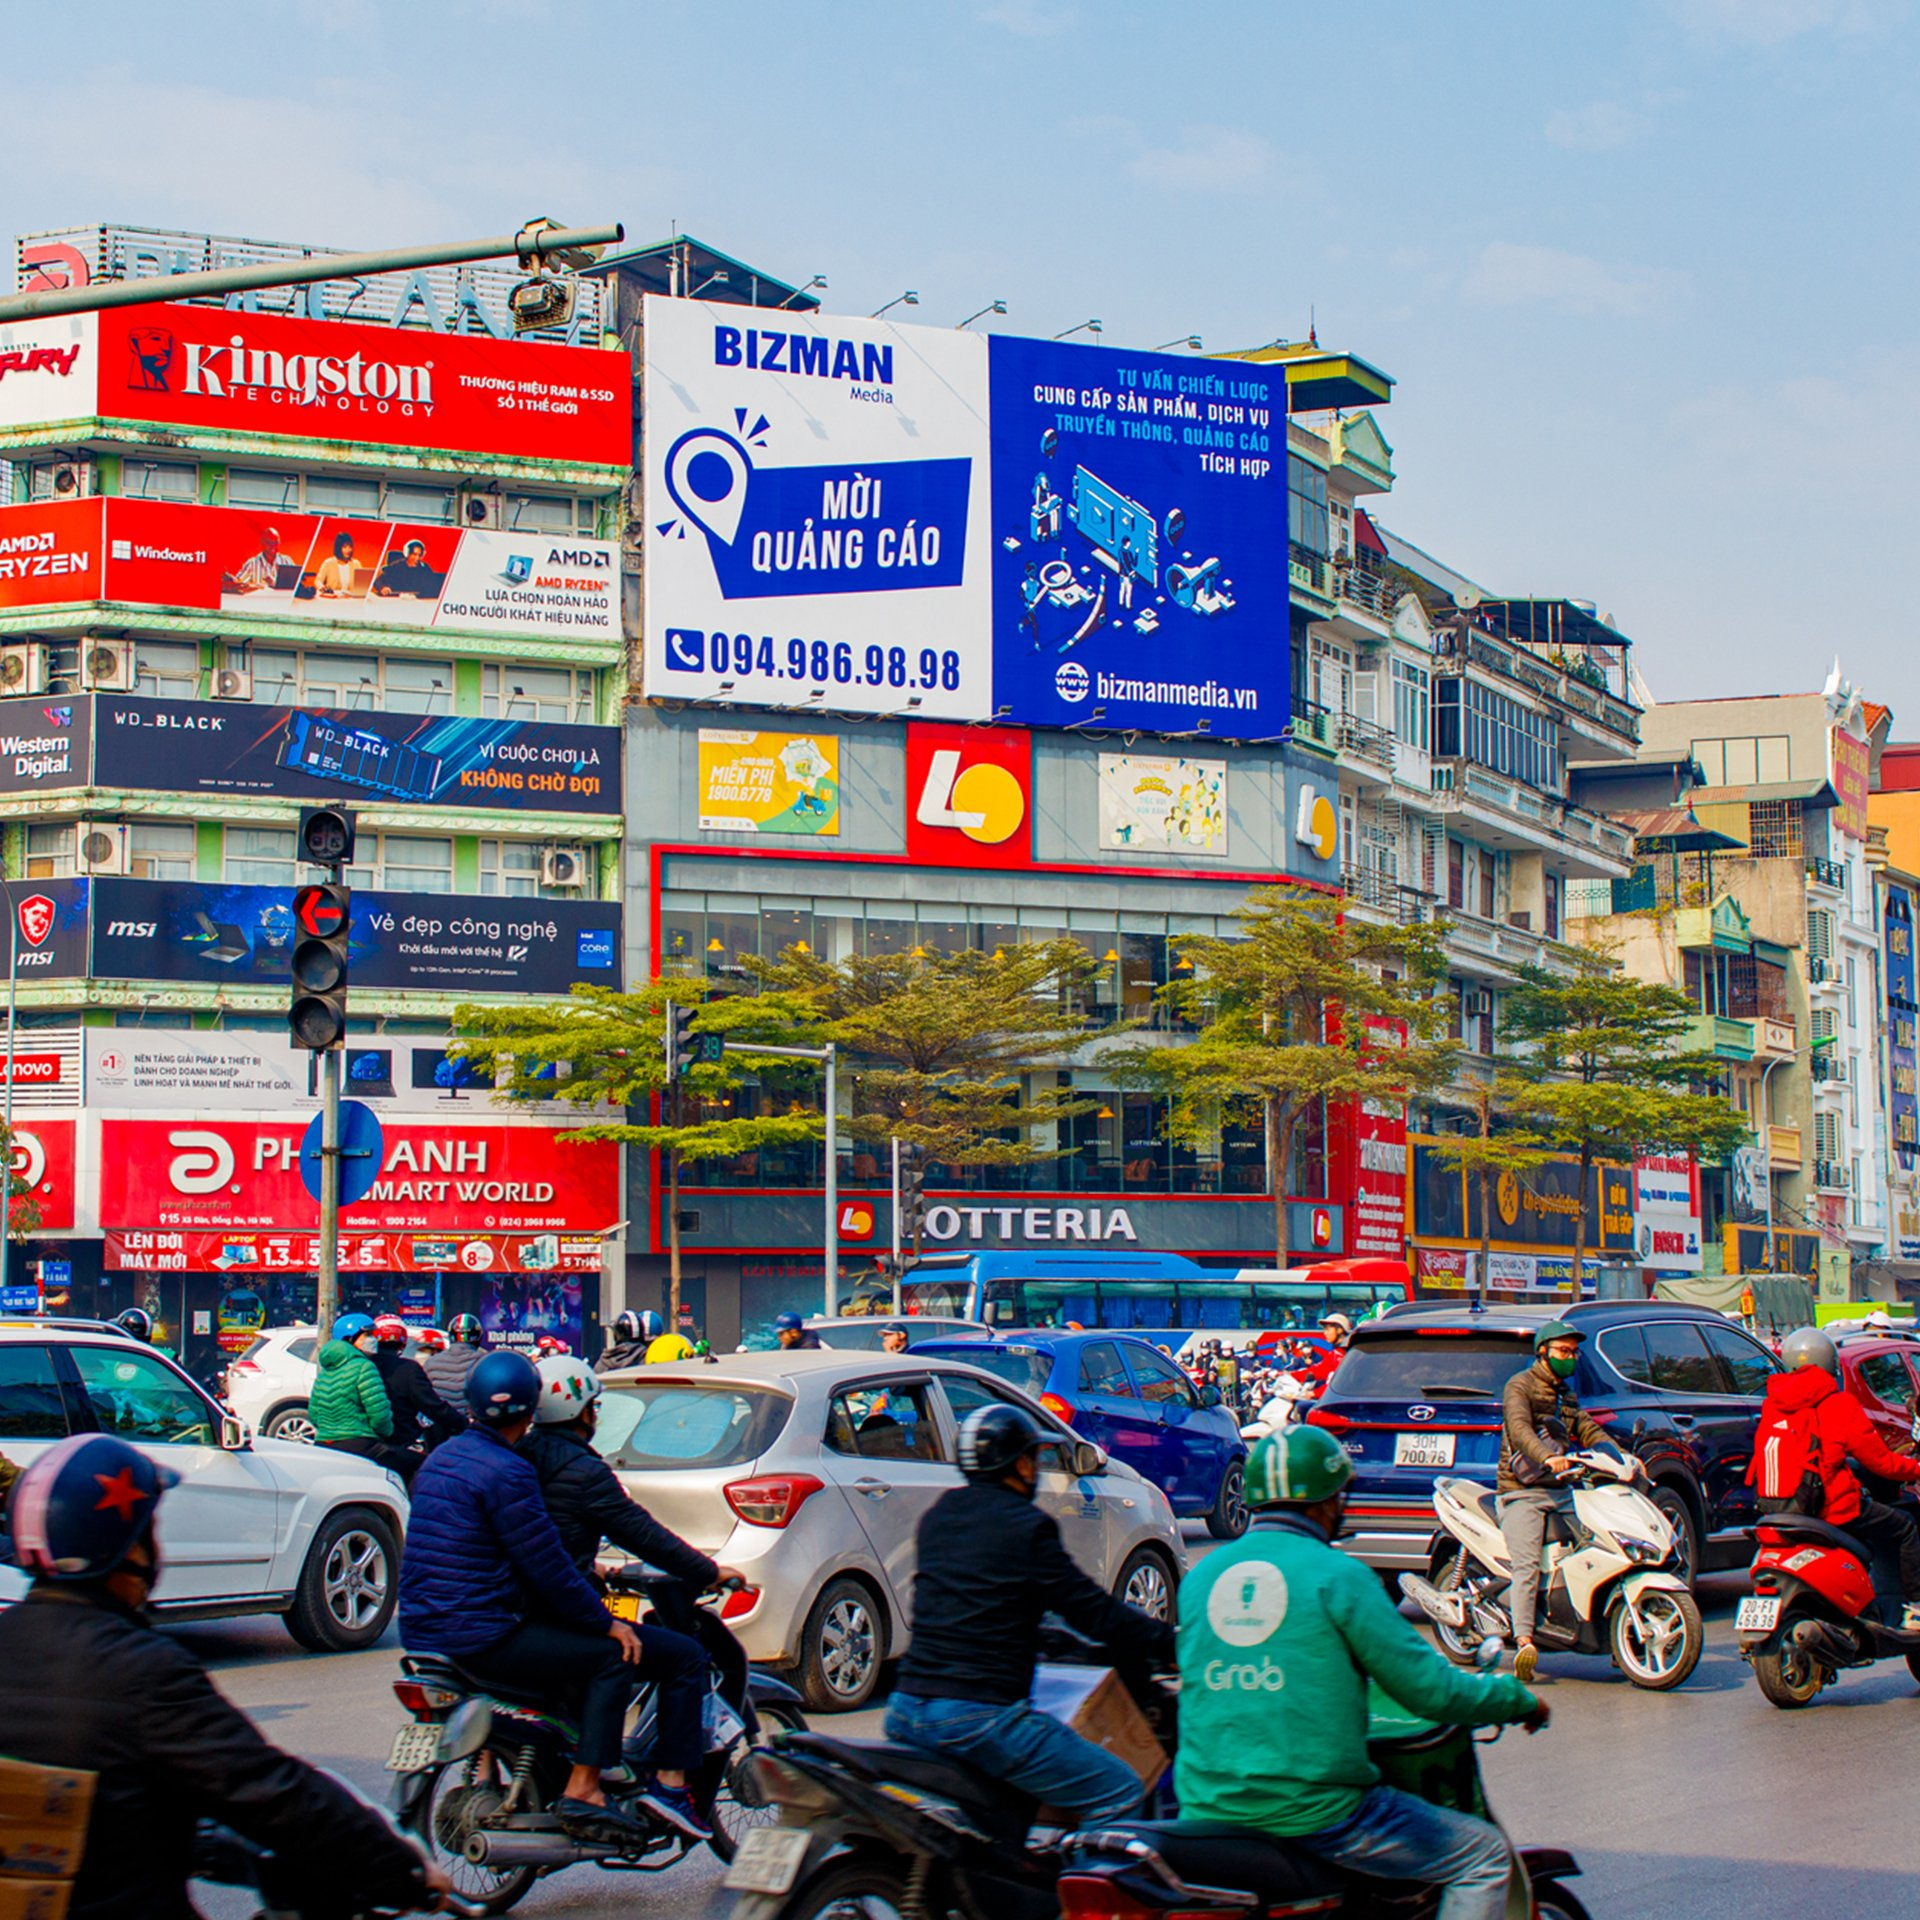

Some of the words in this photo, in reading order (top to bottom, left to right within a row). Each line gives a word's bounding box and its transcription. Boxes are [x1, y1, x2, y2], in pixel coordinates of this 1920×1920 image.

[714, 325, 893, 385] BIZMAN
[459, 375, 516, 392] THƯƠNG
[518, 381, 547, 396] HIỆU
[550, 385, 577, 398] RAM
[579, 388, 589, 400] &
[590, 390, 614, 401] SSD
[850, 387, 893, 404] Media
[1142, 369, 1172, 392] VẤN
[1178, 372, 1224, 398] CHIẾN
[1230, 381, 1269, 402] LƯỢC
[228, 386, 434, 417] TECHNOLOGY
[497, 394, 515, 408] SỐ
[519, 400, 524, 409] 1
[525, 398, 549, 412] THẾ
[551, 400, 578, 415] GIỚI
[1034, 385, 1076, 406] CUNG
[1081, 387, 1112, 410] CẤP
[1117, 390, 1148, 414] SẢN
[1154, 394, 1203, 421] PHẨM,
[1208, 403, 1244, 425] DỊCH
[1249, 408, 1269, 429] VỤ
[1055, 413, 1116, 437] TRUYỀN
[1121, 419, 1178, 445] THÔNG,
[1183, 425, 1234, 449] QUẢNG
[1240, 430, 1269, 452] CÁO
[1199, 452, 1236, 474] TÍCH
[1240, 457, 1270, 480] HỢP
[822, 473, 881, 521] MỜI
[0, 535, 40, 553] AMD
[134, 545, 194, 563] Windows
[195, 551, 206, 563] 11
[751, 518, 864, 573] QUẢNG
[877, 519, 941, 567] CÁO
[547, 548, 592, 566] AMD
[535, 576, 561, 589] AMD
[486, 588, 508, 604] LỰA
[511, 591, 544, 608] CHỌN
[546, 593, 581, 607] HOÀN
[583, 594, 608, 609] HẢO
[442, 602, 467, 615] CHO
[470, 604, 507, 619] NGƯỜI
[509, 607, 541, 622] KHÁT
[544, 610, 572, 626] HIỆU
[710, 632, 960, 691] 094.986.98.98
[1097, 672, 1258, 710] bizmanmedia.vn
[0, 736, 69, 755] Western
[480, 743, 495, 760] VÌ
[498, 743, 538, 763] CUỘC
[542, 746, 577, 764] CHƠI
[581, 749, 600, 765] LÀ
[460, 769, 523, 789] KHÔNG
[528, 772, 565, 792] CHỜ
[569, 775, 600, 796] ĐỢI
[709, 760, 748, 785] MIỄN
[749, 765, 777, 787] PHÍ
[708, 784, 772, 803] 1900.6778
[107, 921, 157, 937] msi
[369, 912, 395, 931] Vẻ
[402, 915, 442, 936] đẹp
[449, 917, 501, 940] công
[508, 920, 558, 942] nghệ
[17, 951, 55, 966] msi
[159, 1067, 177, 1076] CHO
[179, 1067, 207, 1076] DOANH
[134, 1079, 154, 1088] LINH
[383, 1139, 488, 1174] ANH
[456, 1181, 555, 1203] WORLD
[168, 1213, 179, 1223] 15
[386, 1217, 405, 1226] 1900
[499, 1217, 521, 1227] (024)
[124, 1230, 154, 1249] LÊN
[156, 1231, 183, 1249] ĐỜI
[222, 1235, 257, 1243] LAPTOP
[120, 1251, 154, 1269] MÁY
[157, 1251, 187, 1269] MỚI
[262, 1247, 290, 1266] 1.3
[359, 1247, 373, 1265] 5
[467, 1251, 477, 1266] 8
[563, 1257, 571, 1267] 5
[1412, 1435, 1438, 1449] 30H
[1205, 1655, 1284, 1691] Grab
